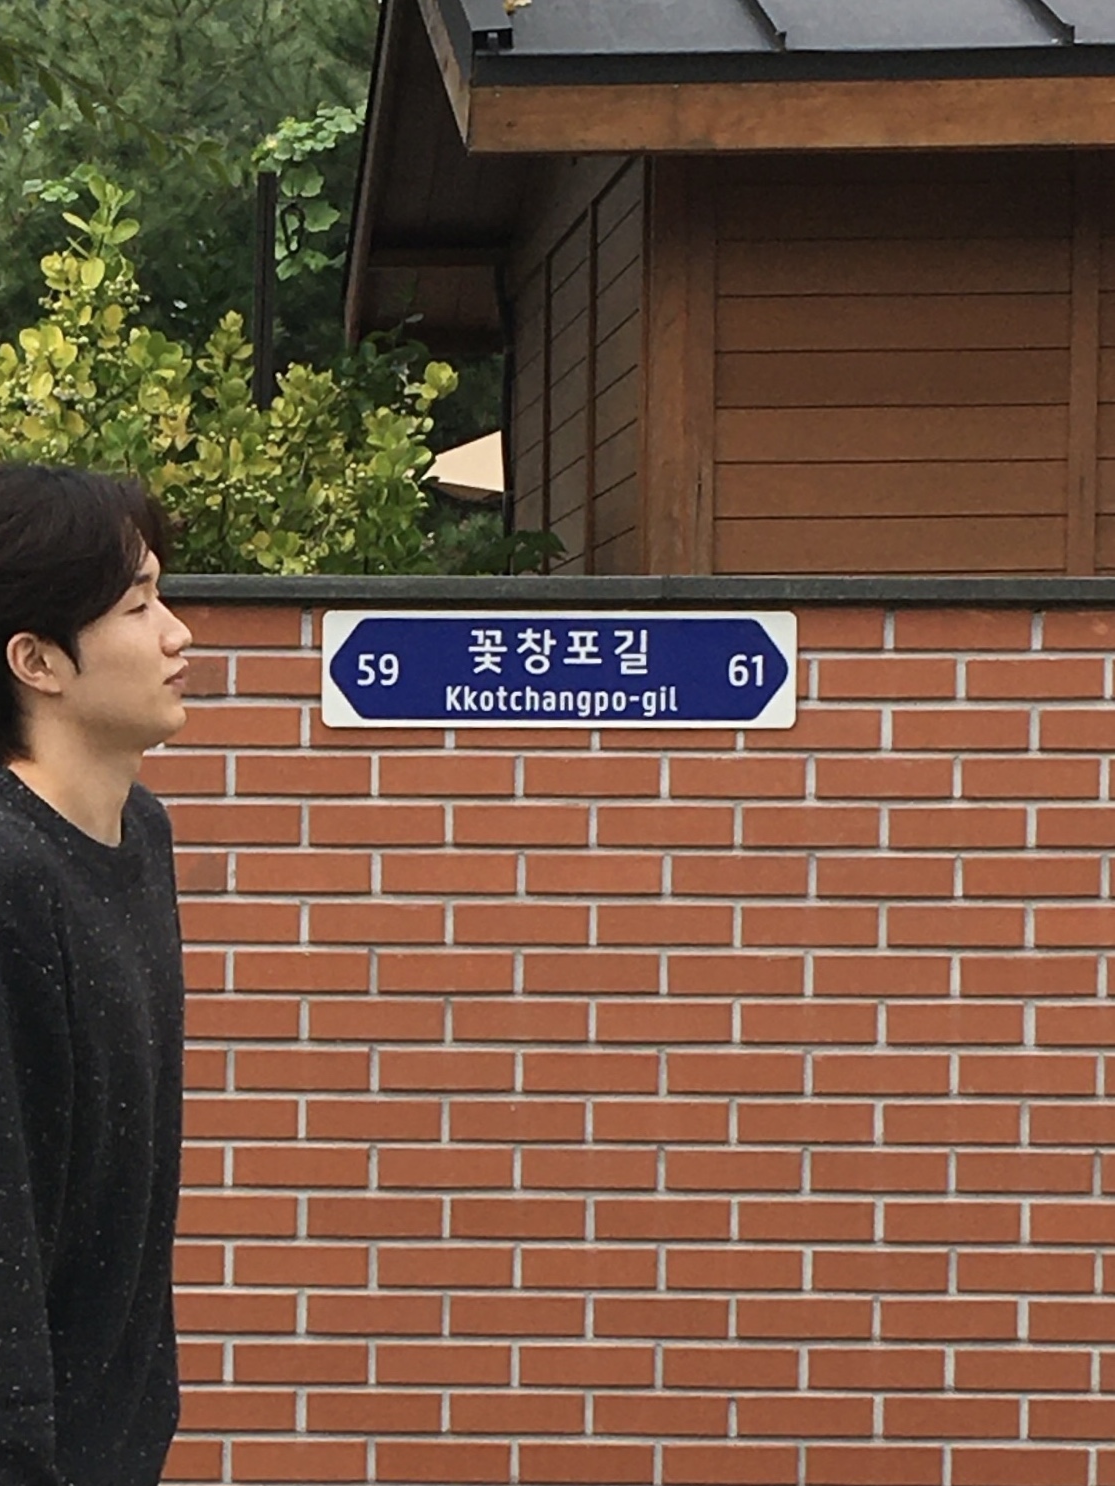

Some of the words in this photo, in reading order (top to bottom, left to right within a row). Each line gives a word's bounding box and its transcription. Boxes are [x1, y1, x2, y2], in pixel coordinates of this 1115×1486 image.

[468, 628, 649, 675] 꽃창포길
[357, 653, 399, 686] 59
[728, 654, 765, 687] 61
[446, 685, 679, 718] Kkotchangpo-gil
